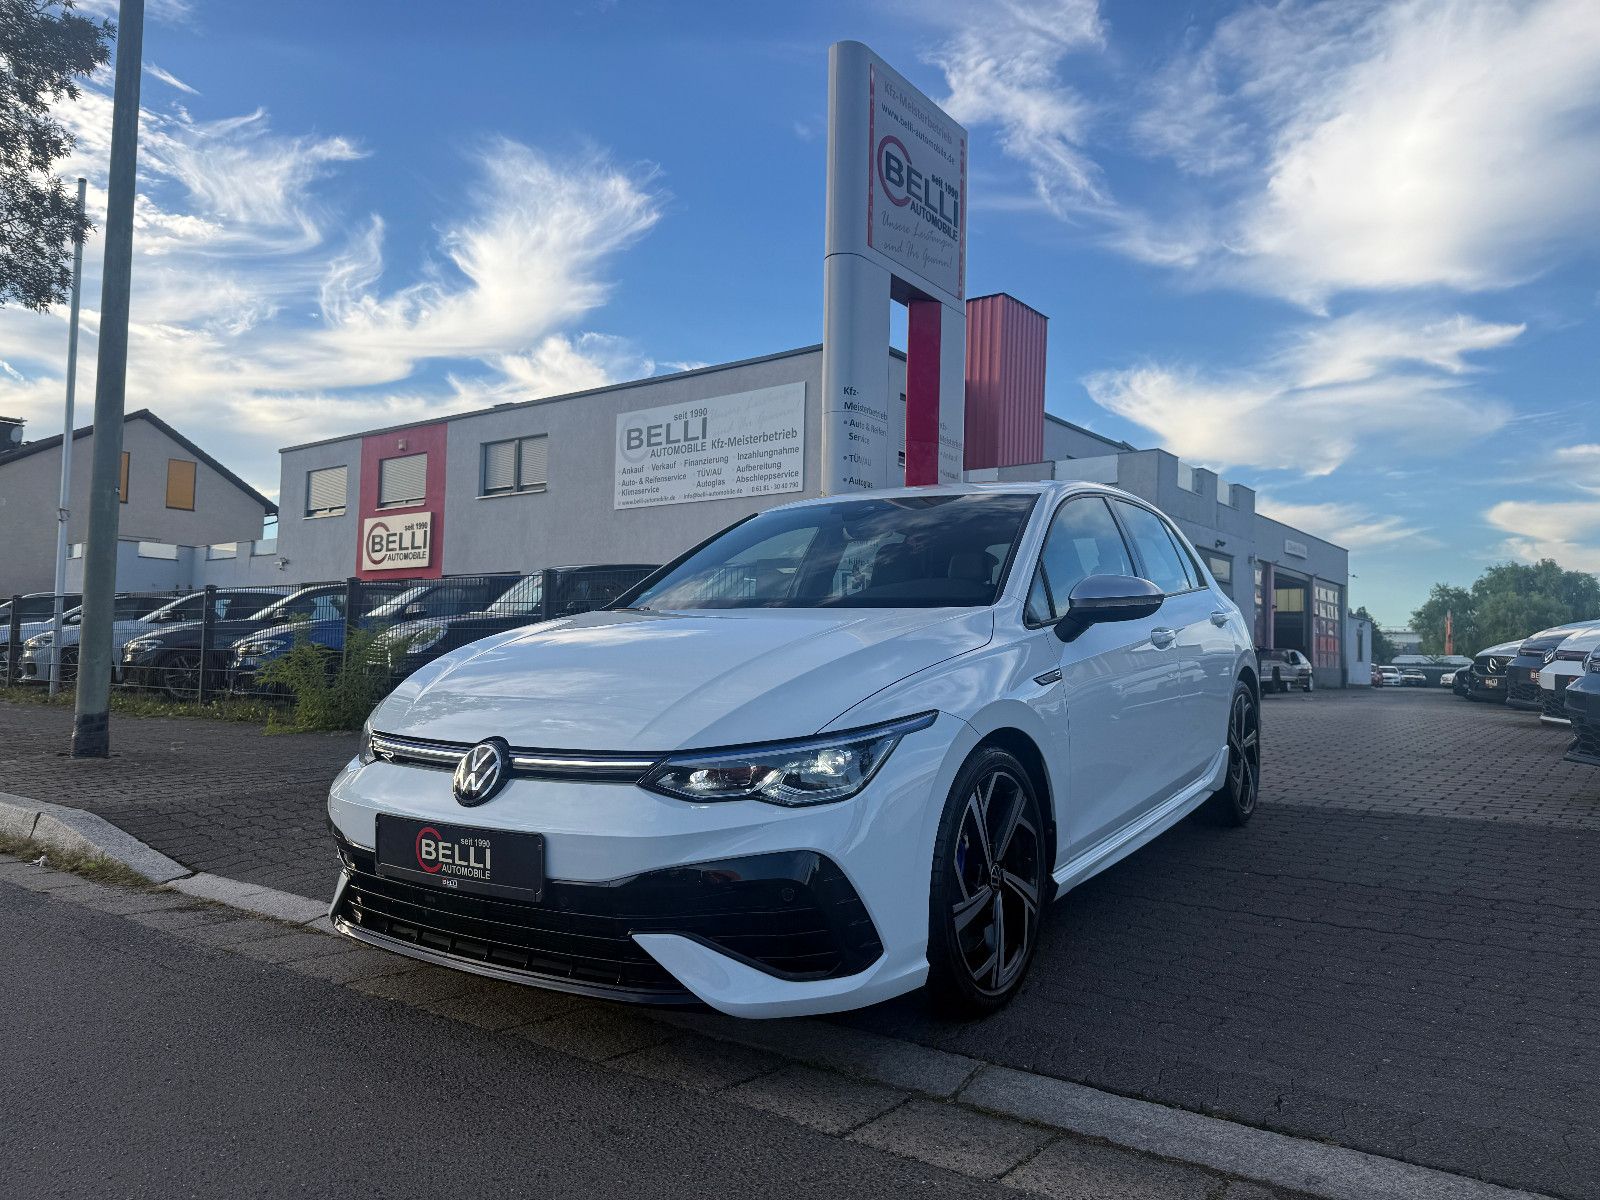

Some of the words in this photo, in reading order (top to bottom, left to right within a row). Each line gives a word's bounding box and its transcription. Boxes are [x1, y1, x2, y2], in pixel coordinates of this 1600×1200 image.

[885, 150, 959, 228] BELLI
[910, 200, 958, 241] AUTOMOBILE
[843, 386, 859, 396] Kfz-
[673, 412, 688, 422] seit
[690, 407, 708, 419] 1990
[626, 416, 708, 451] BELLI
[649, 441, 707, 458] AUTOMOBILE
[711, 427, 798, 450] Kfz-Meisterbetrieb
[621, 464, 645, 475] Ankauf
[651, 460, 677, 471] Verkauf
[683, 455, 729, 468] Finanzierung
[737, 445, 800, 461] Inzahlungnahme
[645, 473, 687, 484] Reifenservice
[735, 460, 782, 474] Aufbereitung
[621, 485, 660, 497] Klimaservice
[696, 478, 726, 489] Autoglas
[736, 469, 800, 484] Abschleppservice
[416, 521, 428, 530] 1990
[371, 530, 428, 553] BELLI
[387, 551, 427, 561] AUTOMOBILE
[421, 838, 491, 870] BELLI
[460, 837, 473, 847] seit
[474, 838, 491, 848] 1990
[441, 864, 491, 880] AUTOMOBILE
